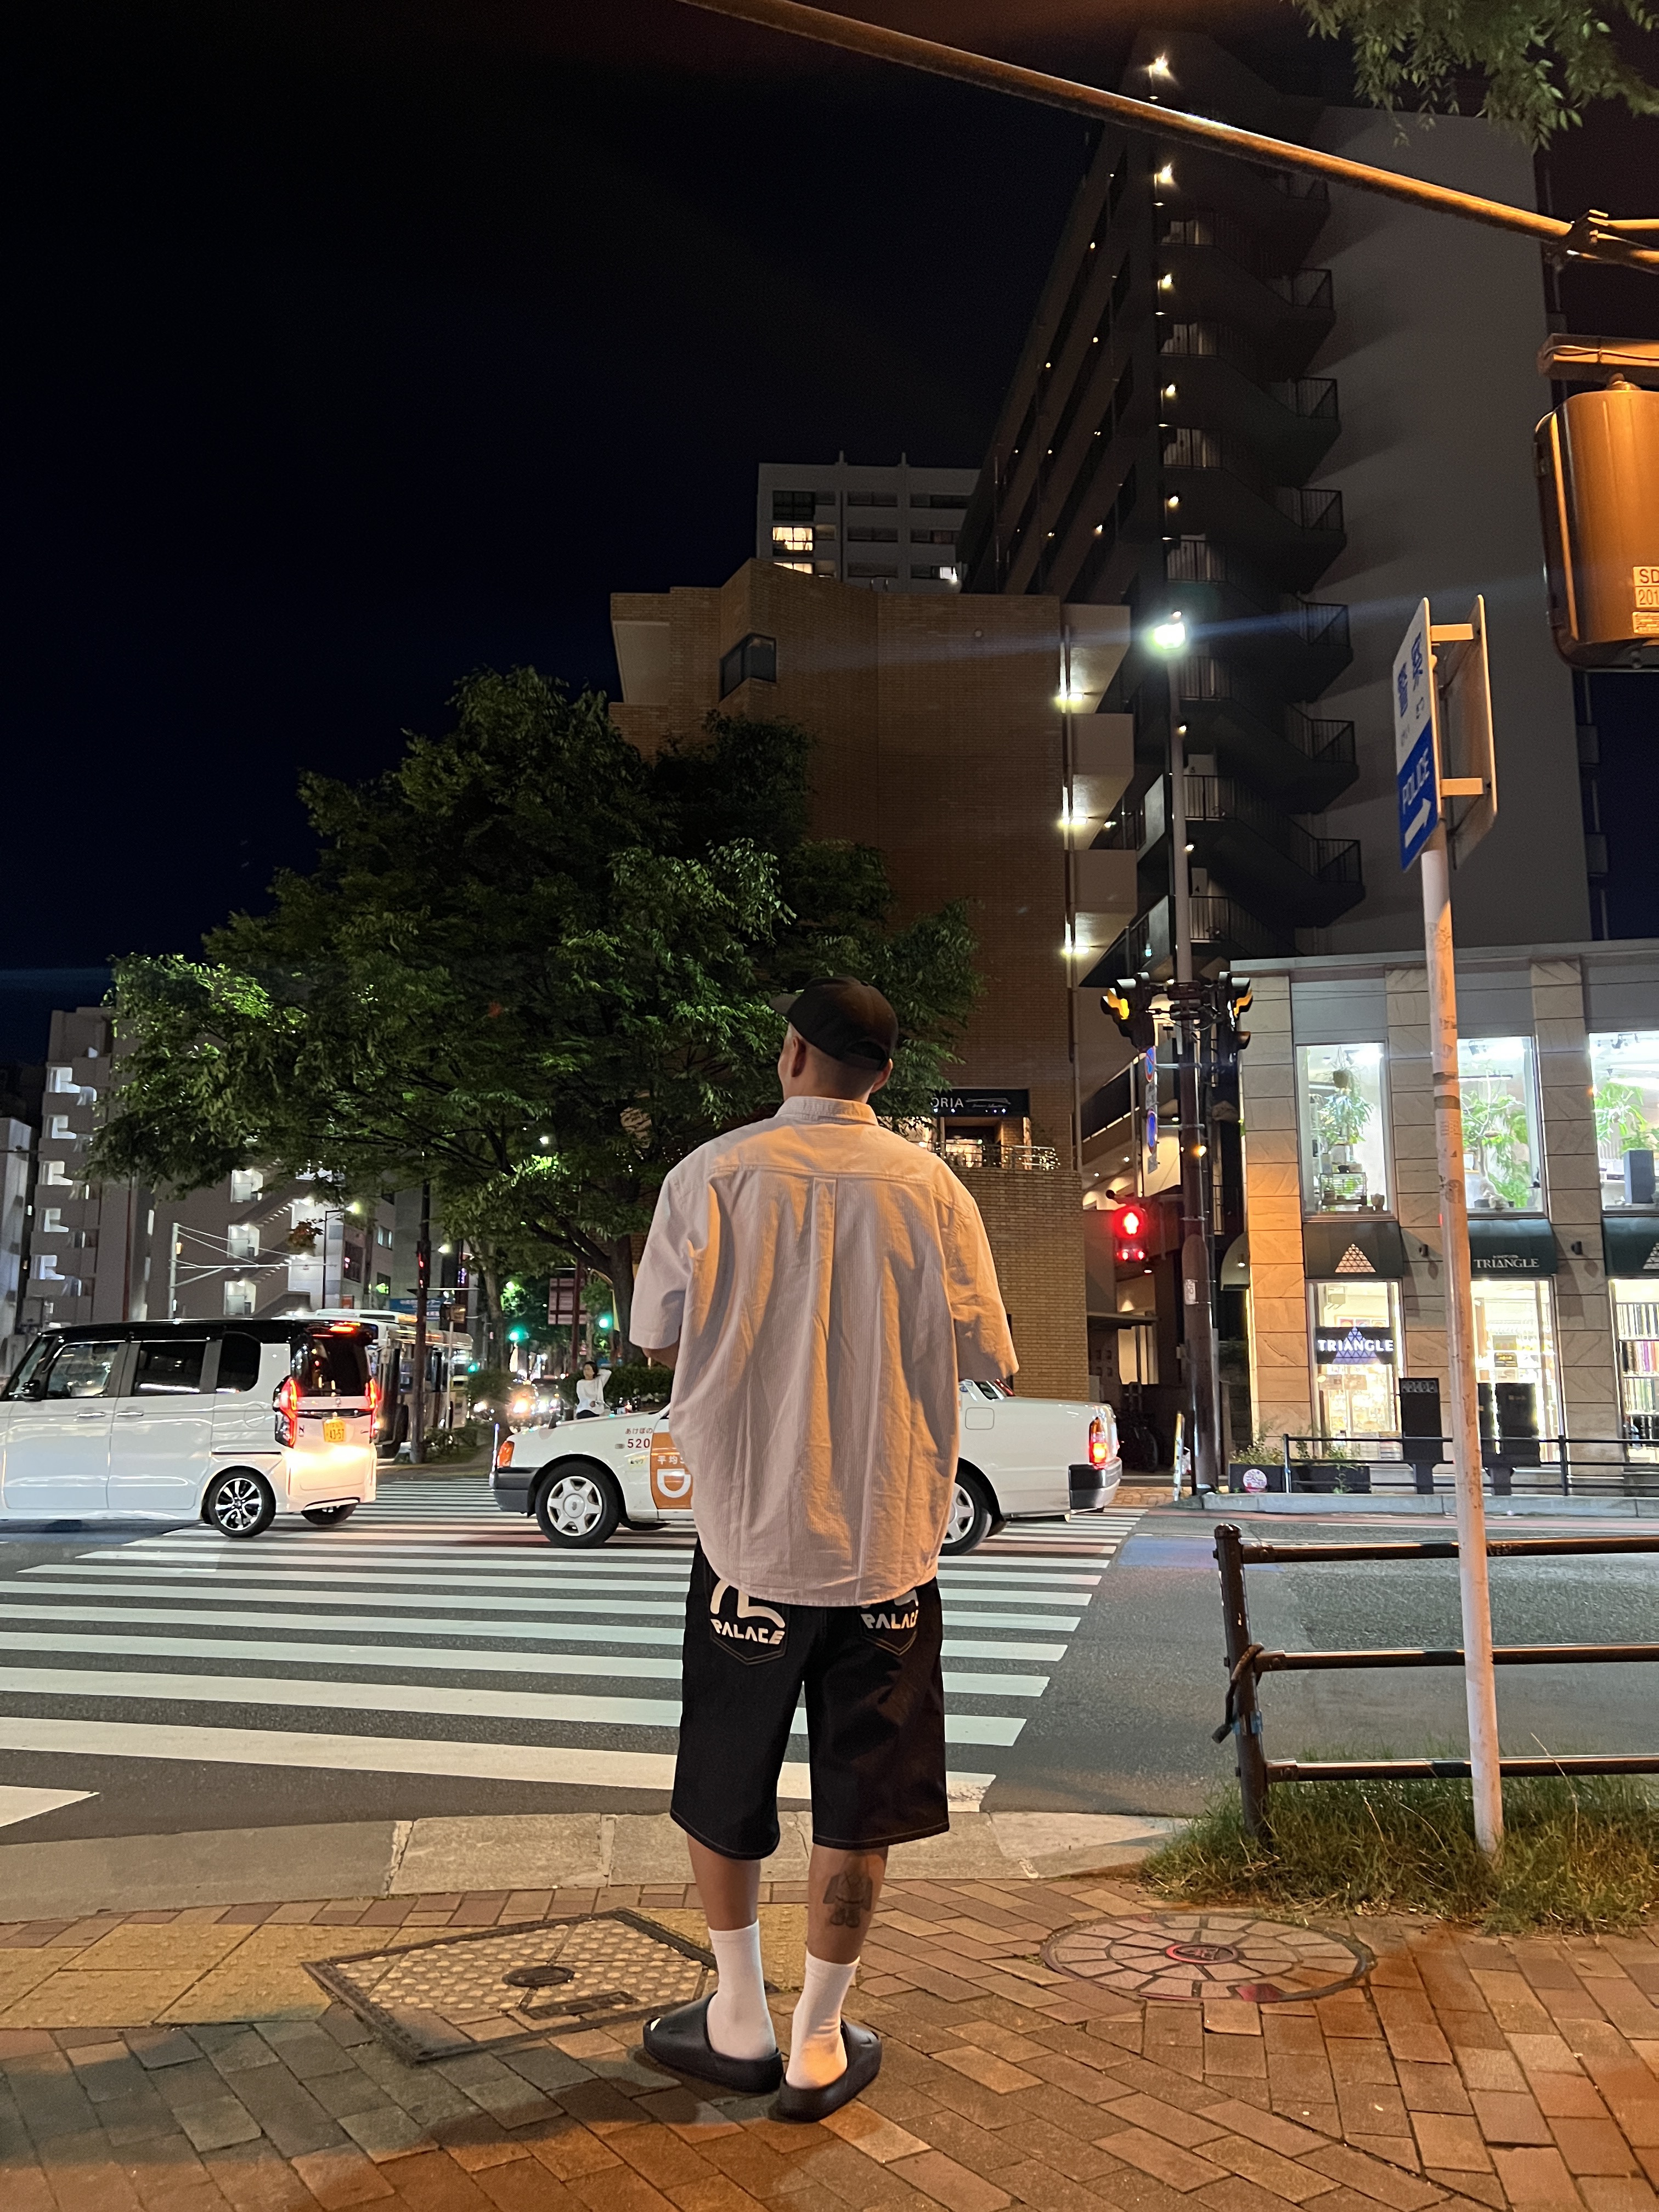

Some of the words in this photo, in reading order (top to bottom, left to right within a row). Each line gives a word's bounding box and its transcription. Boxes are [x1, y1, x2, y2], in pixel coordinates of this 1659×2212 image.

[1402, 747, 1430, 815] POLICE
[1474, 1259, 1540, 1268] TRIANGLE
[1317, 1339, 1394, 1352] TRIANGLE
[627, 1438, 650, 1448] 520
[710, 1618, 785, 1645] PALACE
